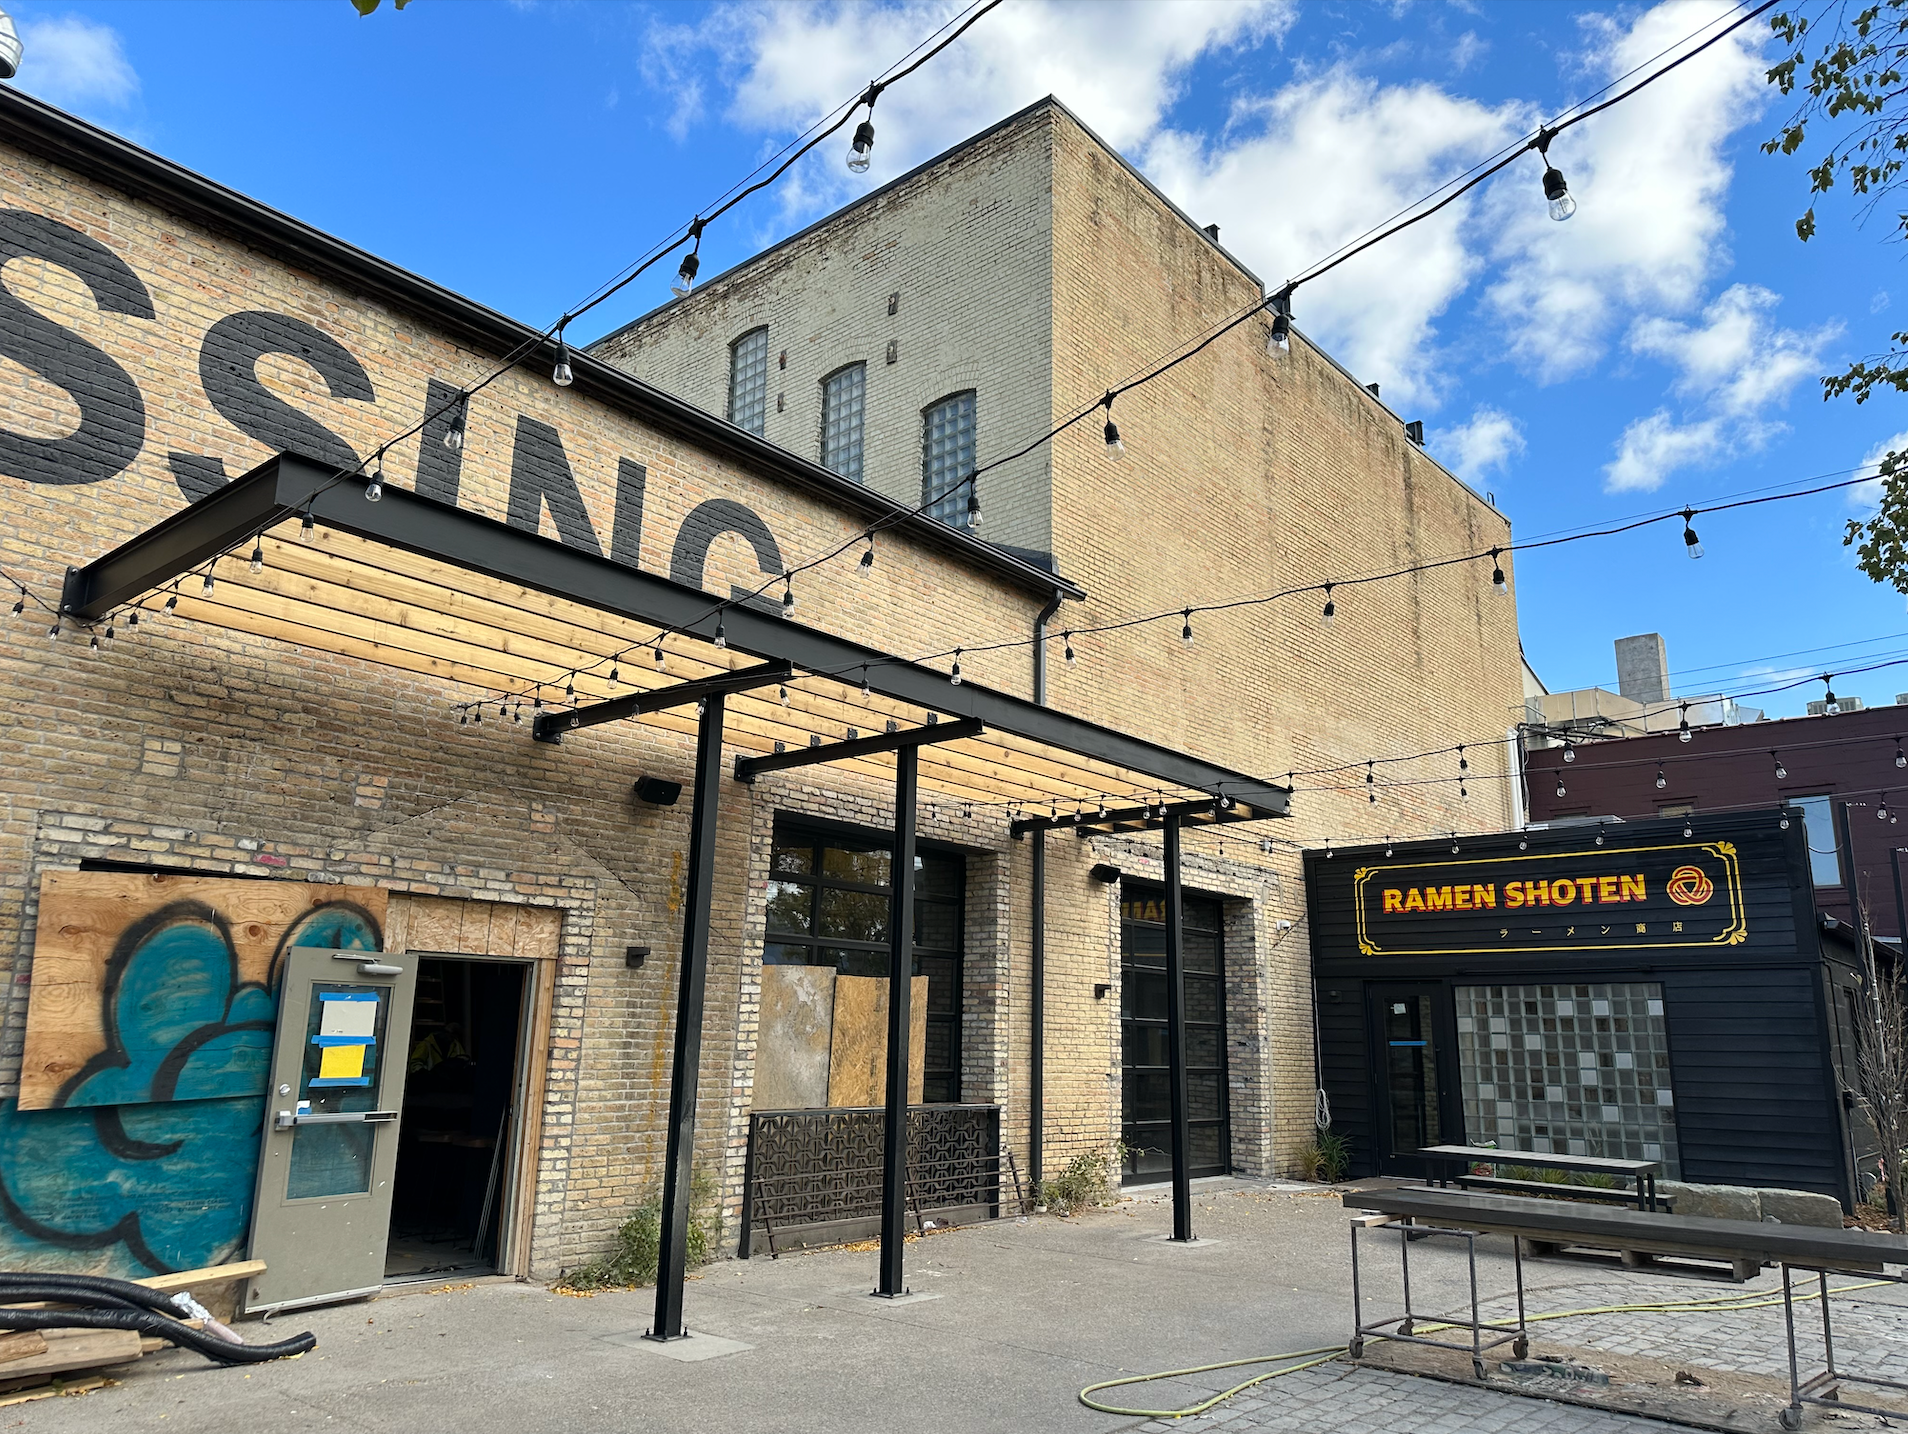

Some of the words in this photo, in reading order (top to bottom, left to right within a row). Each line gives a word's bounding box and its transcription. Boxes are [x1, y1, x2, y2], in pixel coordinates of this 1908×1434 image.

[1383, 884, 1497, 913] RAMEN
[1504, 874, 1647, 908] SHOTEN
[1500, 921, 1683, 938] ラーメン商店
